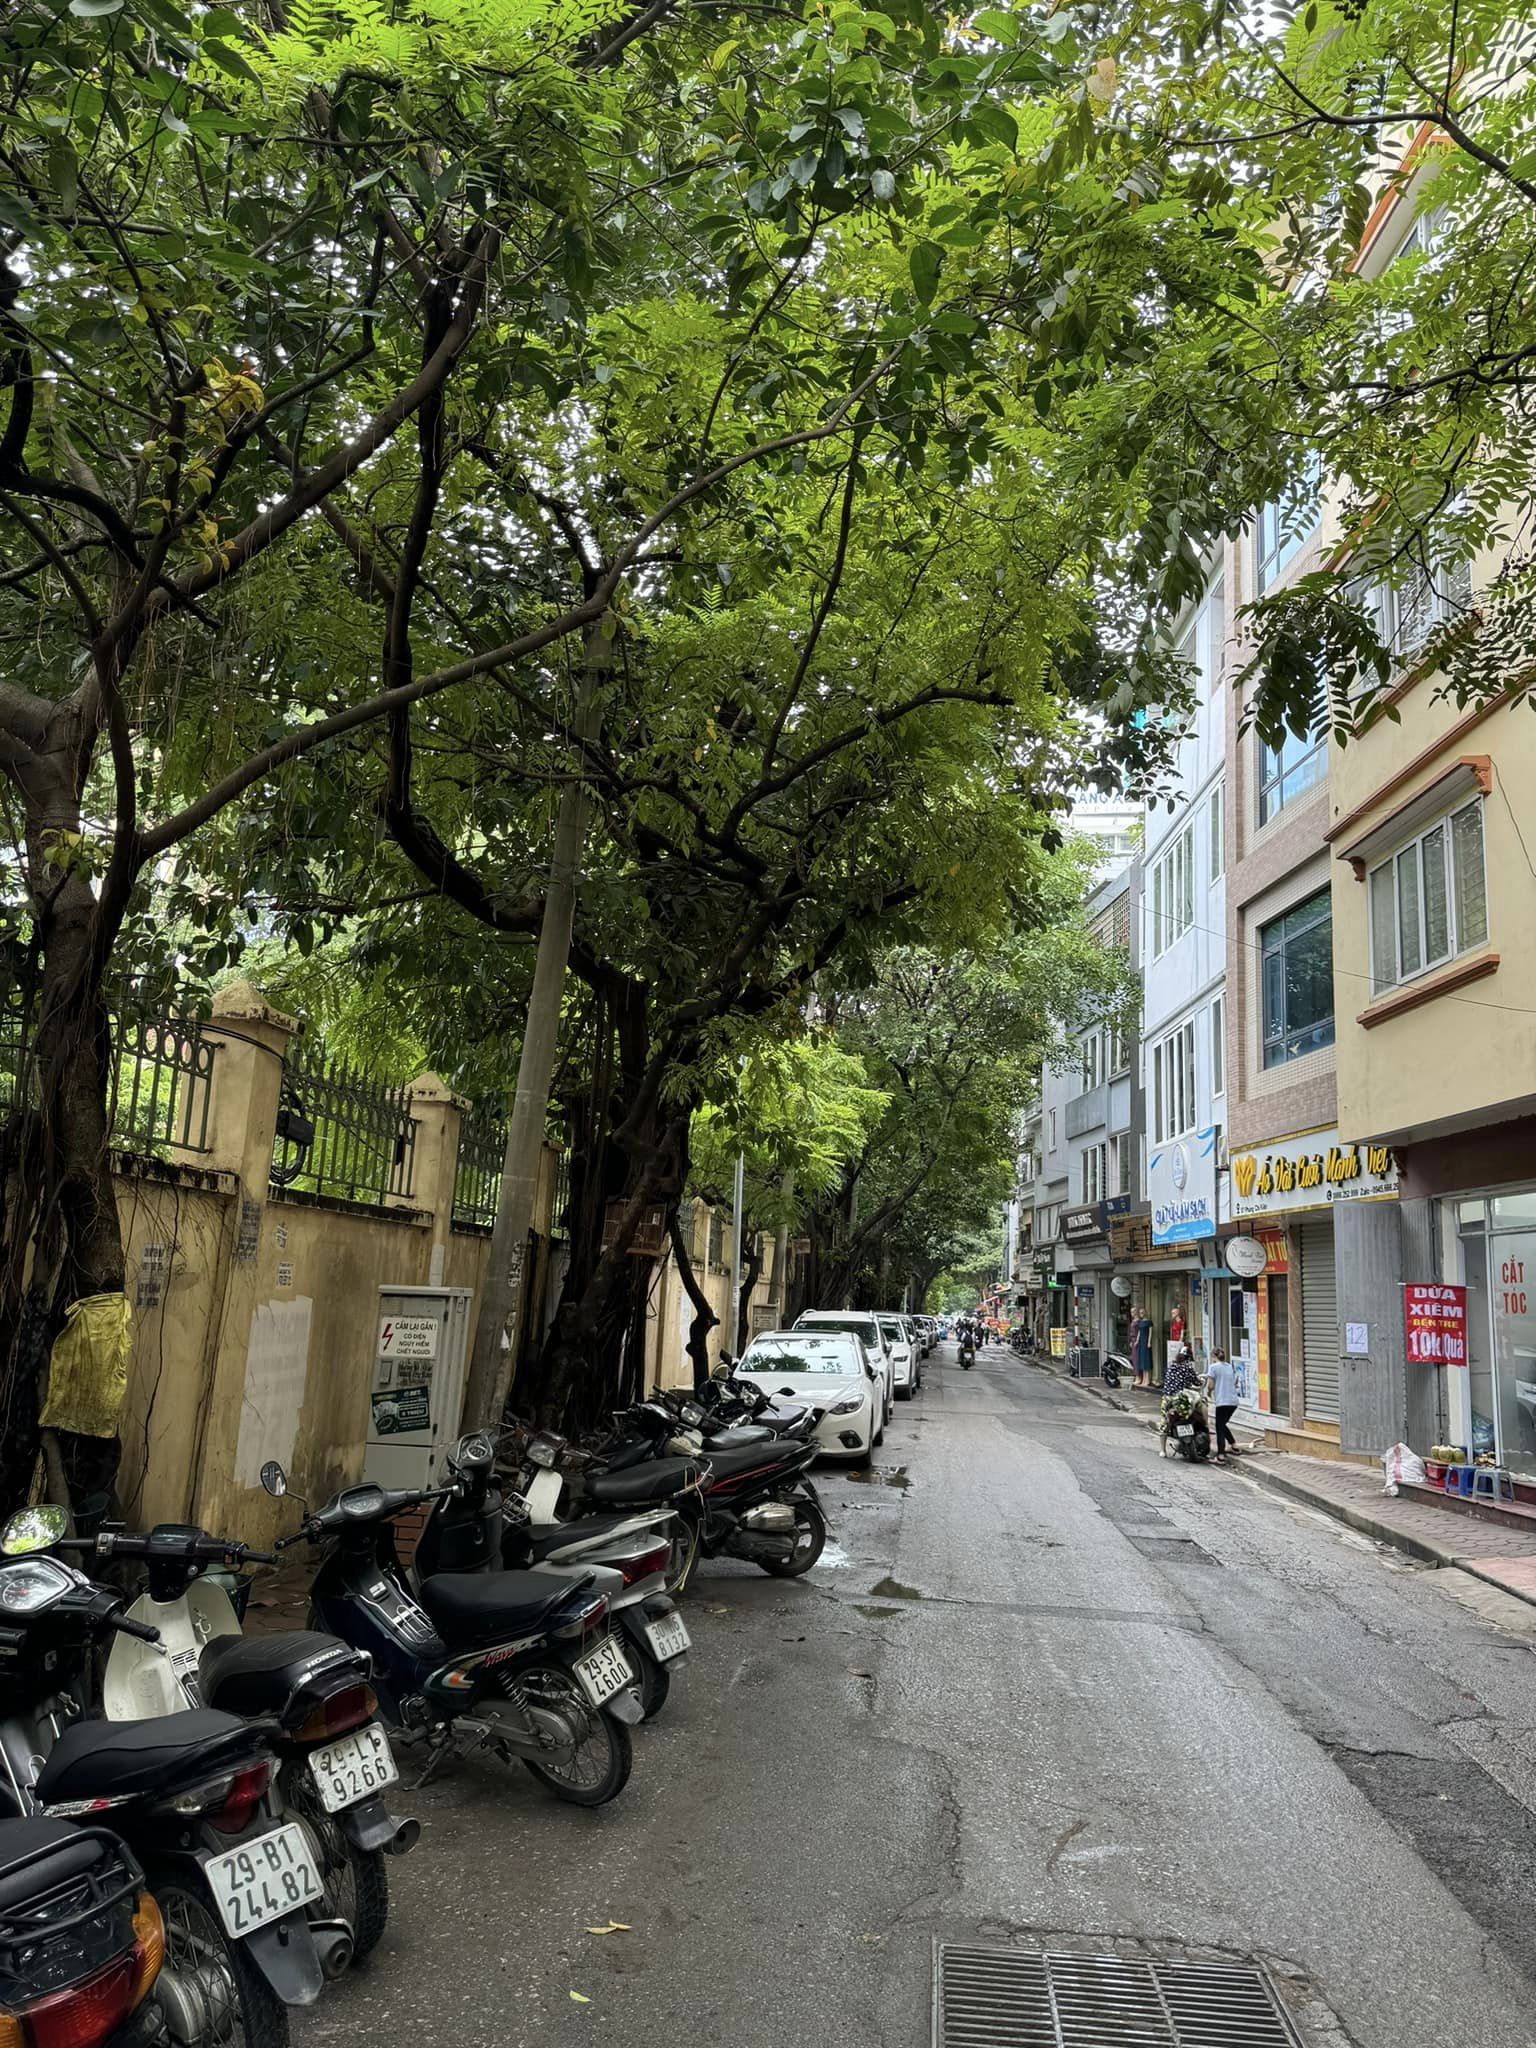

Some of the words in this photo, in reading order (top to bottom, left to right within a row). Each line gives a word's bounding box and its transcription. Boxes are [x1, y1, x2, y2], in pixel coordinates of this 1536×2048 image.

[1326, 1145, 1360, 1186] Mạnh
[1502, 1254, 1524, 1284] CẮT
[1413, 1284, 1456, 1300] DỪA
[1503, 1288, 1527, 1315] TÓC
[1410, 1302, 1463, 1318] XIÊM
[1347, 1326, 1367, 1345] 12
[305, 1649, 344, 1668] HONDA
[658, 1632, 688, 1656] 8132
[584, 1644, 618, 1680] 29-S7
[594, 1662, 629, 1697] 4600
[322, 1731, 379, 1776] 29-L1
[333, 1757, 387, 1801] 9266
[222, 1833, 296, 1890] 29-B1
[227, 1864, 317, 1930] 244.82
